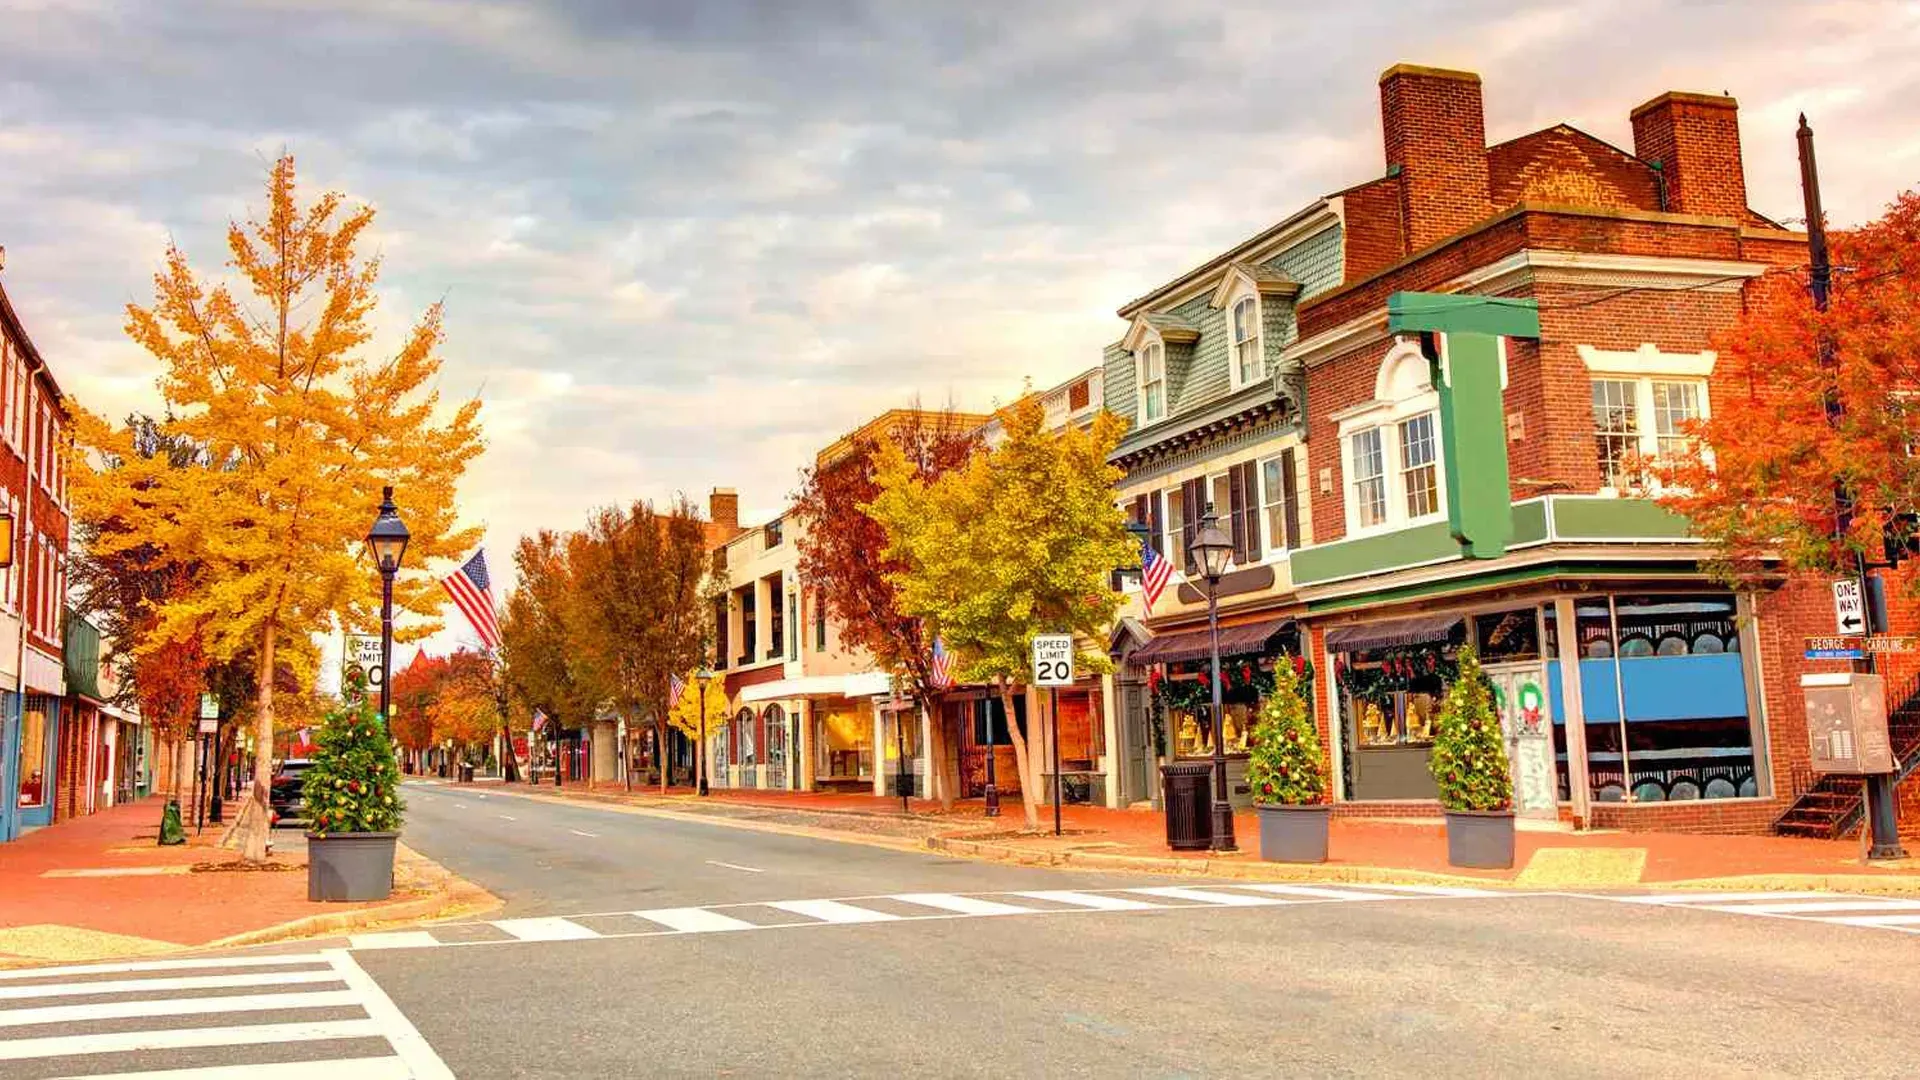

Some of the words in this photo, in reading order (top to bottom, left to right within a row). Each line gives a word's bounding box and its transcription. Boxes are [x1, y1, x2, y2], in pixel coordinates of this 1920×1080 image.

[1837, 581, 1857, 597] ONE
[1839, 598, 1859, 612] WAY
[350, 641, 383, 651] PEE
[1036, 640, 1069, 649] SPEED
[1811, 638, 1845, 650] GEORGE
[355, 653, 383, 662] IMIT
[1040, 651, 1065, 660] LIMIT
[1038, 661, 1069, 680] 20
